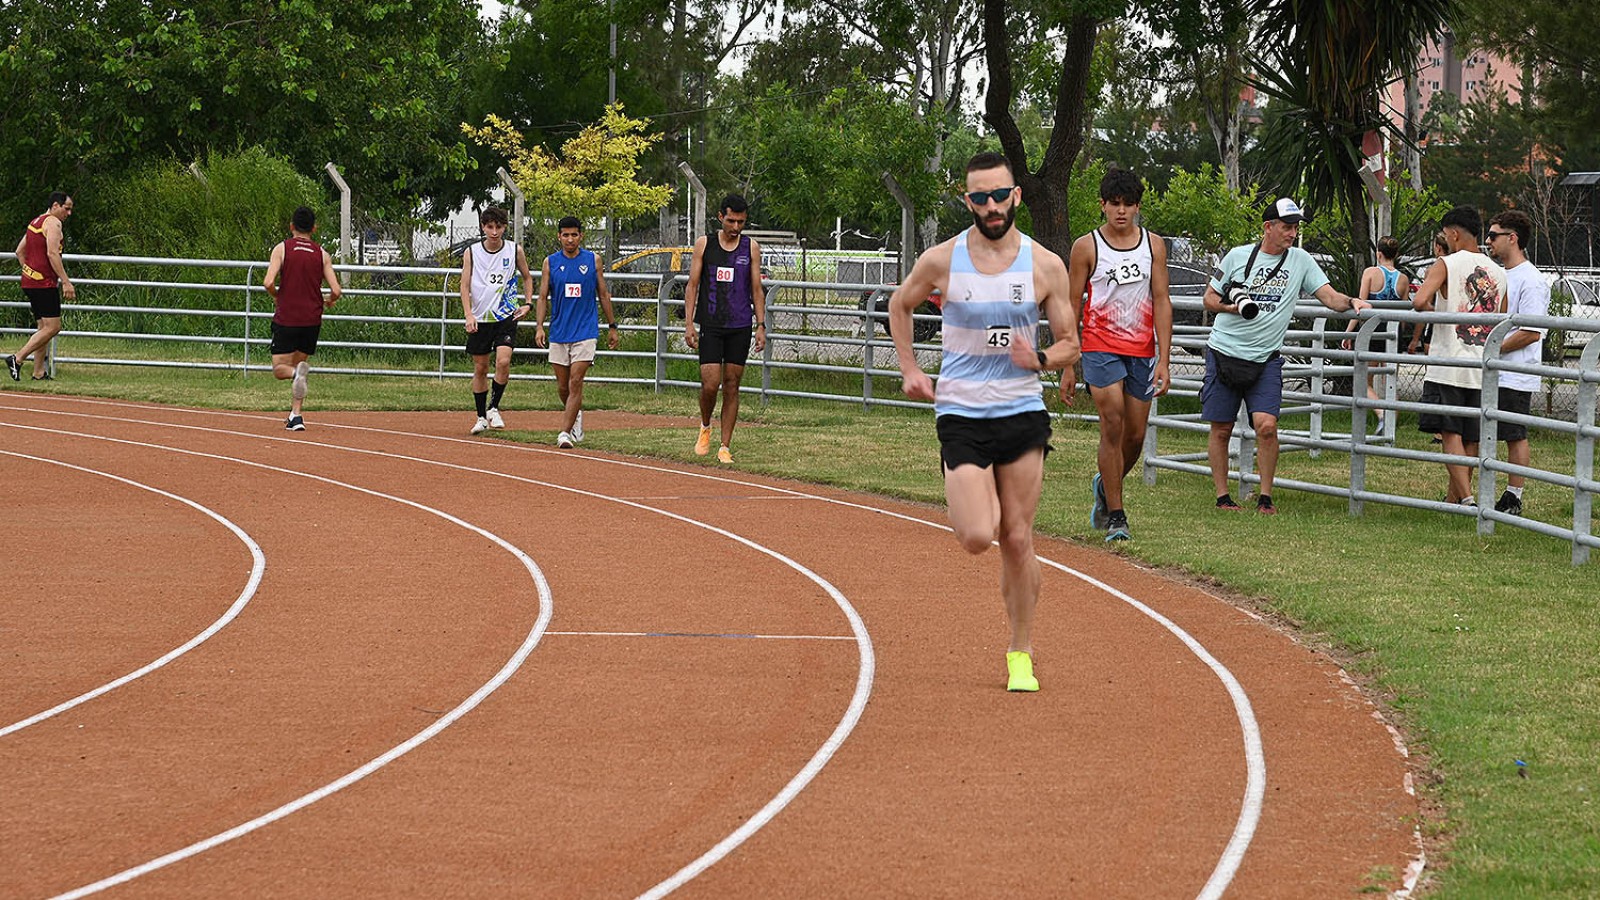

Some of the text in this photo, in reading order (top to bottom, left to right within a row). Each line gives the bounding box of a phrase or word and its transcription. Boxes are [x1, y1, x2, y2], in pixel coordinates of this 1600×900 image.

[717, 269, 731, 280] 80
[1120, 263, 1141, 279] 33
[1255, 267, 1290, 280] ASCS
[489, 273, 504, 284] 32
[1252, 277, 1288, 287] GODEN
[568, 286, 580, 297] 73
[1267, 286, 1286, 295] 2024
[988, 332, 1010, 347] 45
